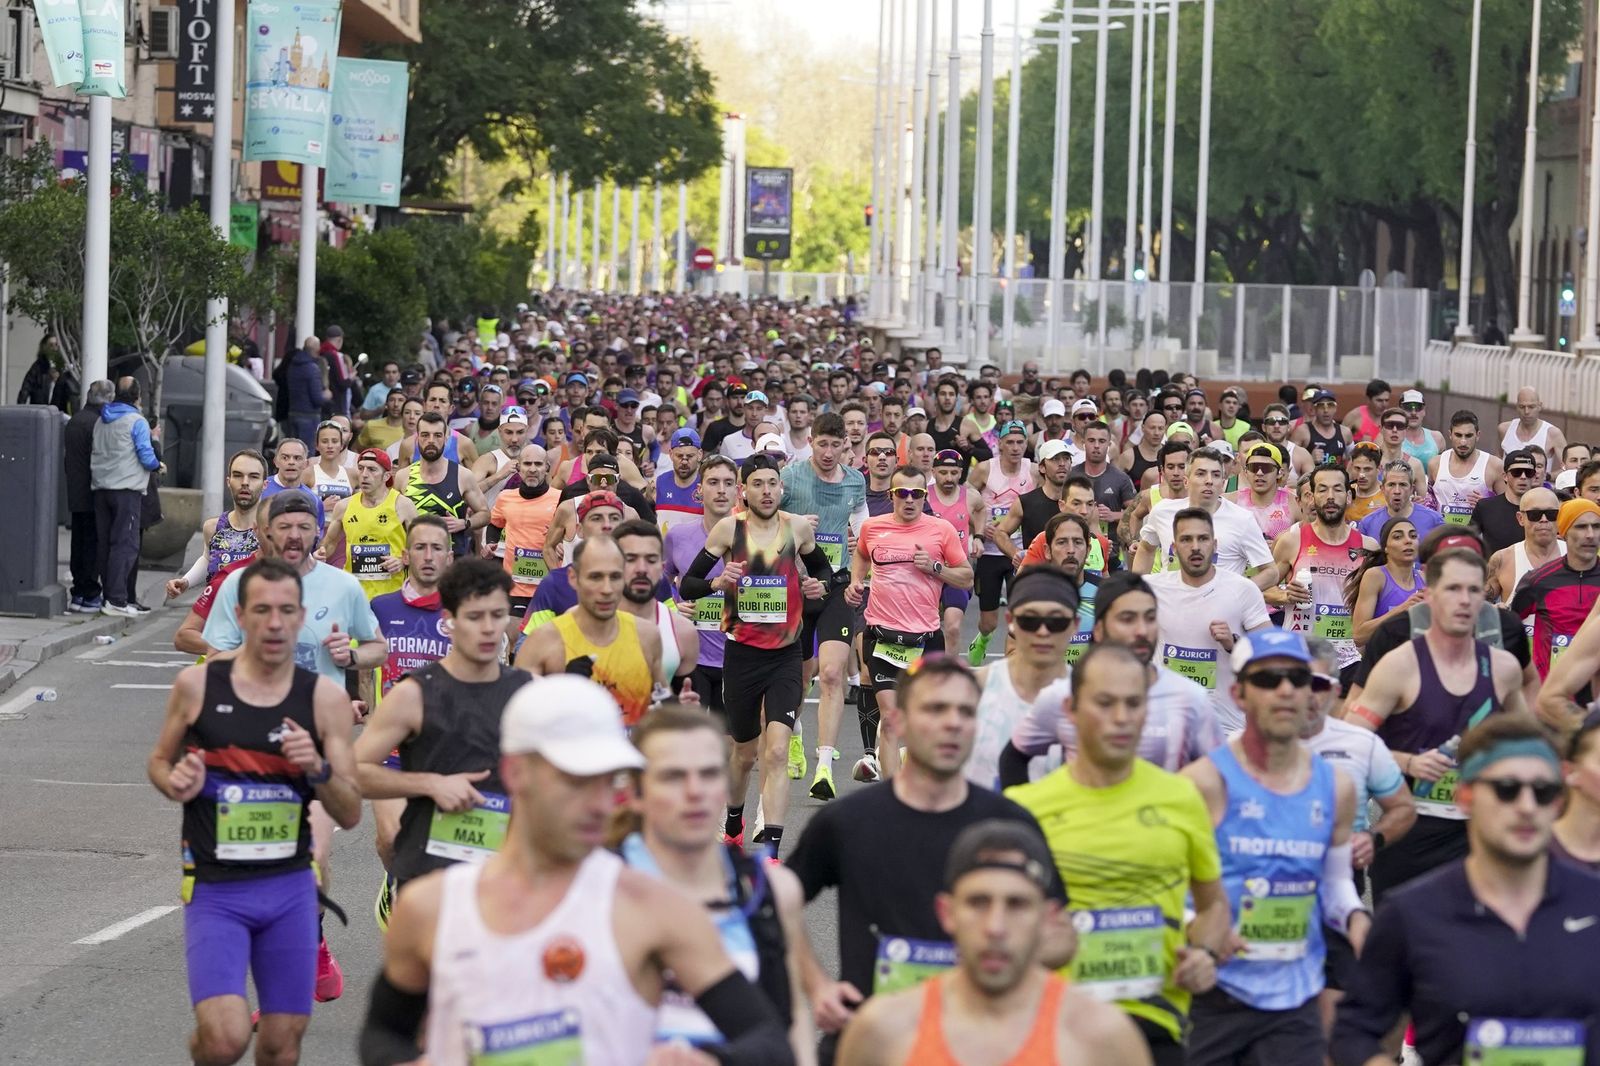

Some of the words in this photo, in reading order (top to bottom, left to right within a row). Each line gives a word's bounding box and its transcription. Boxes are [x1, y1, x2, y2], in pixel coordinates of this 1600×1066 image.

[249, 90, 327, 114] SEVILLA
[816, 534, 840, 542] ZURICH
[363, 545, 386, 553] ZURICH
[359, 564, 383, 573] JAIME
[518, 567, 544, 577] SERGIO
[754, 578, 782, 586] ZURICH
[739, 601, 760, 611] RUBI
[698, 611, 722, 620] PAUL
[1326, 628, 1346, 638] PEPE
[885, 650, 909, 663] MSAL
[1179, 650, 1211, 660] ZURICH
[1179, 665, 1196, 673] 3245
[247, 788, 294, 800] ZURICH
[228, 826, 257, 841] LEO
[262, 824, 289, 840] M-S
[453, 827, 486, 846] MAX
[1099, 908, 1155, 927] ZURICH
[1077, 956, 1141, 978] AHMED
